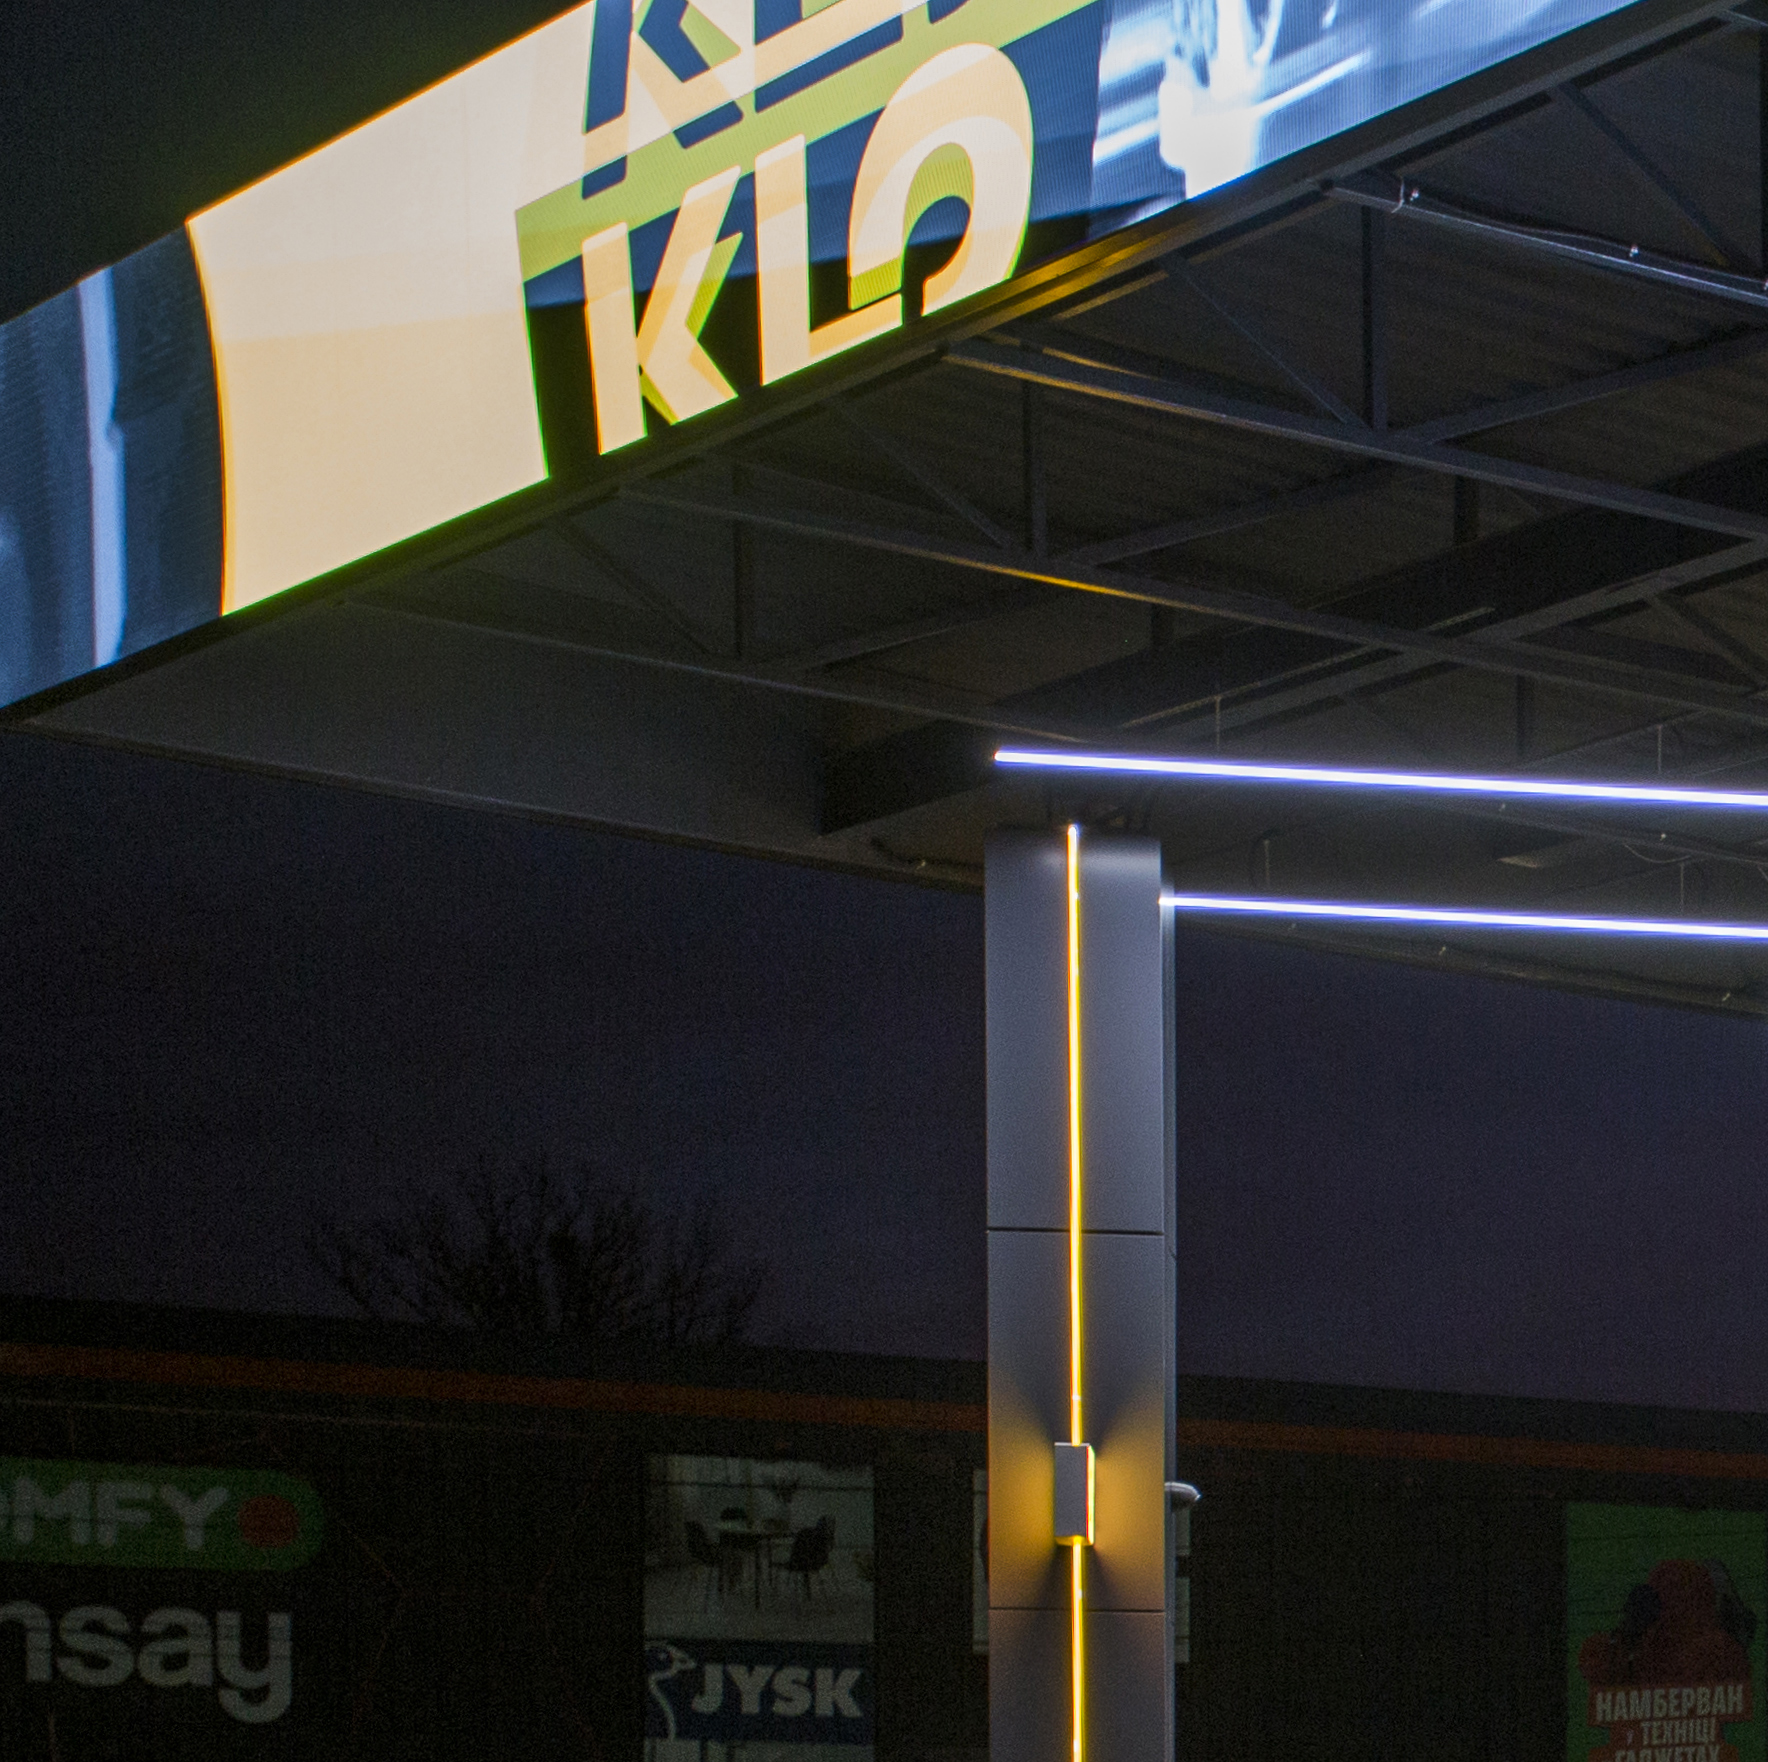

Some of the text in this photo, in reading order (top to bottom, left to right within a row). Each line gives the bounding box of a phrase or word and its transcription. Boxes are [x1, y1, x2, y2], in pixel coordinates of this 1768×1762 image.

[582, 42, 1034, 456] KLO
[0, 1476, 229, 1550] MFY
[691, 1661, 865, 1719] JYSK
[1595, 1684, 1744, 1723] НАМБЕРВАН
[1640, 1717, 1716, 1747] ТЕХНІЦІ
